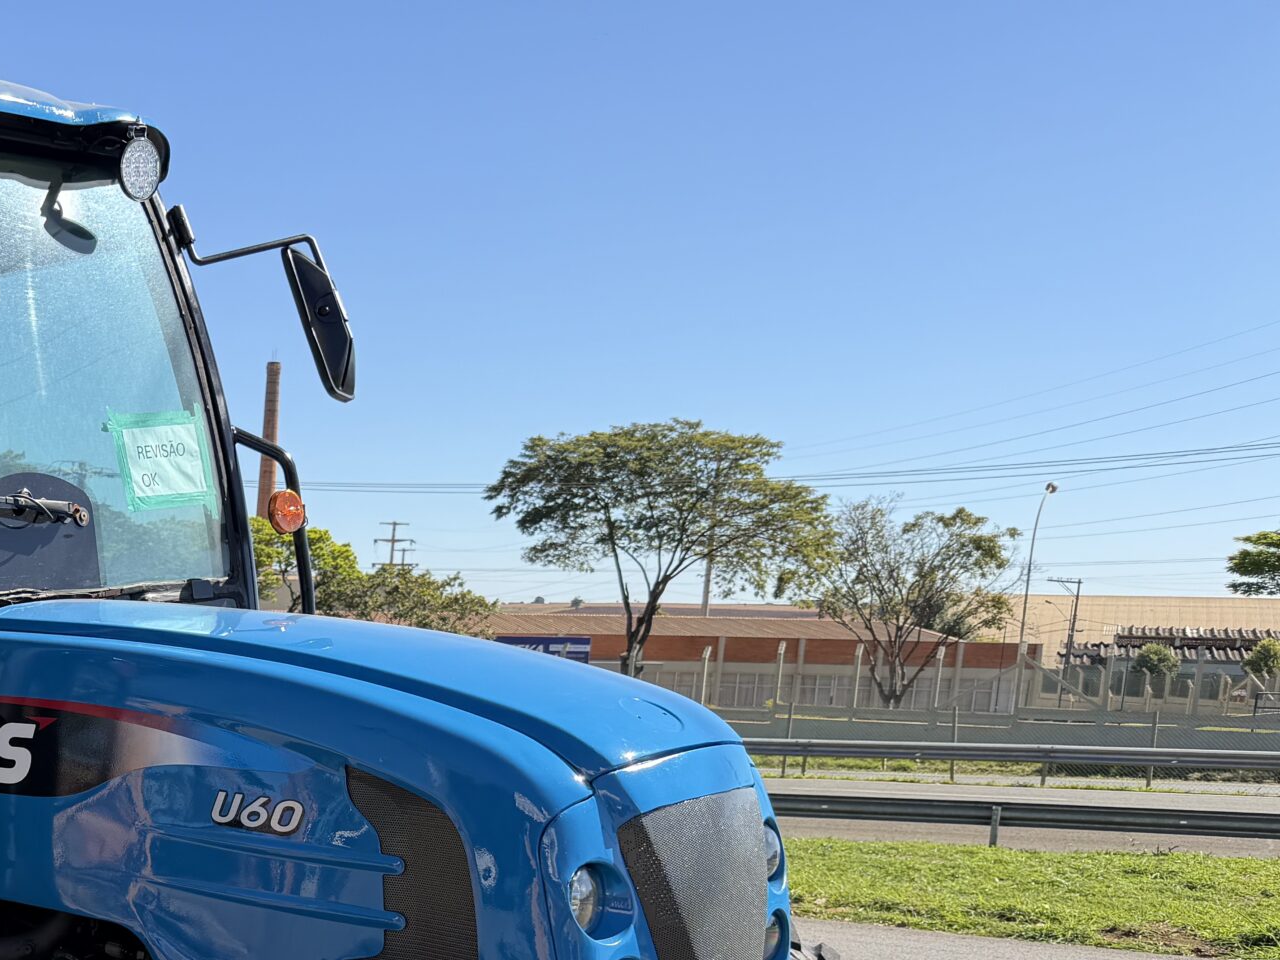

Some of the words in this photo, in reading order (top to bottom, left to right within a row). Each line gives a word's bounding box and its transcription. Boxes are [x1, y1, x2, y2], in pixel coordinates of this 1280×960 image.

[136, 440, 186, 460] REVISÃO
[141, 472, 160, 488] OK
[210, 790, 305, 834] U60
